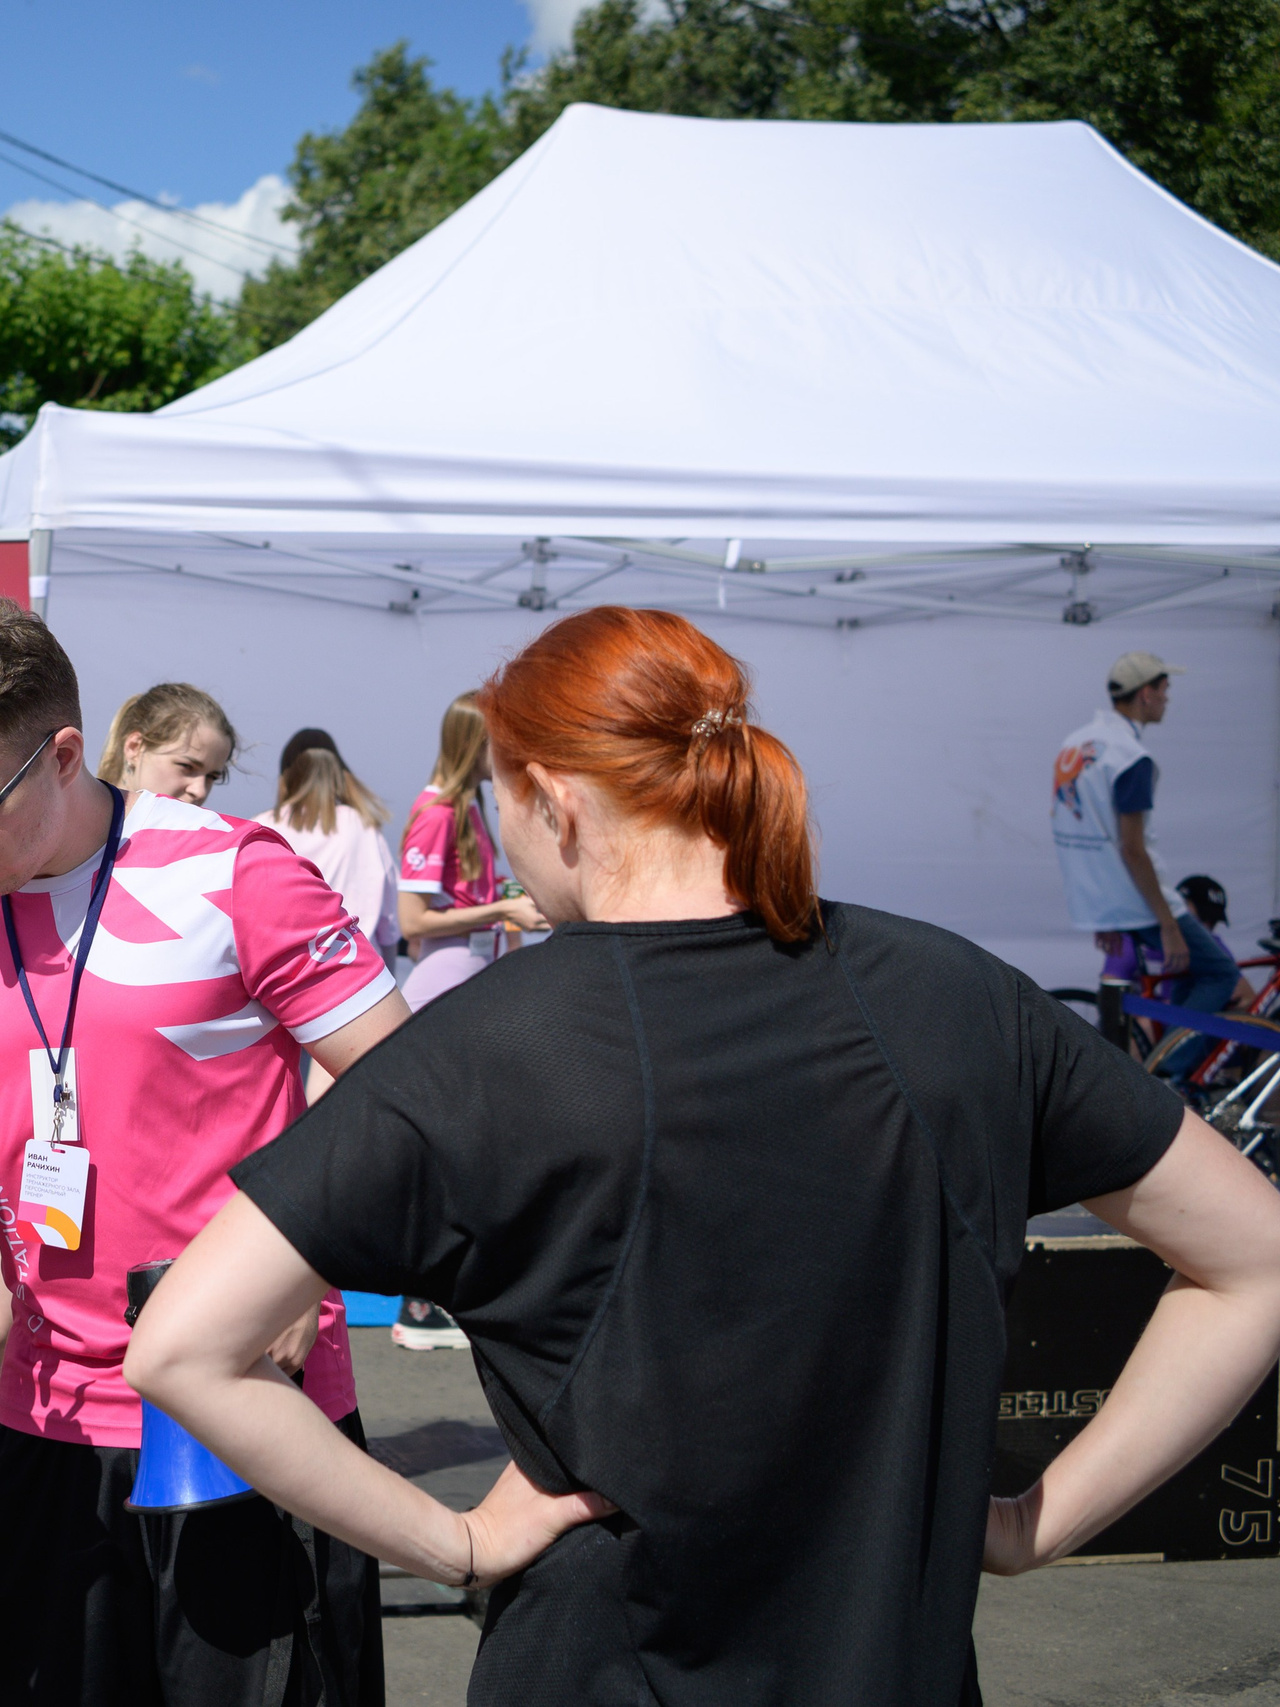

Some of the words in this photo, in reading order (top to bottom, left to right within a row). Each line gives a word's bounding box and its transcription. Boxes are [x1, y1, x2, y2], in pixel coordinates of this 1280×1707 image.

[28, 1153, 48, 1162] ИВАН
[27, 1161, 60, 1173] РАЧИХИН
[26, 1173, 59, 1182] ИНСТРУКТОР
[1219, 1459, 1272, 1546] 75
